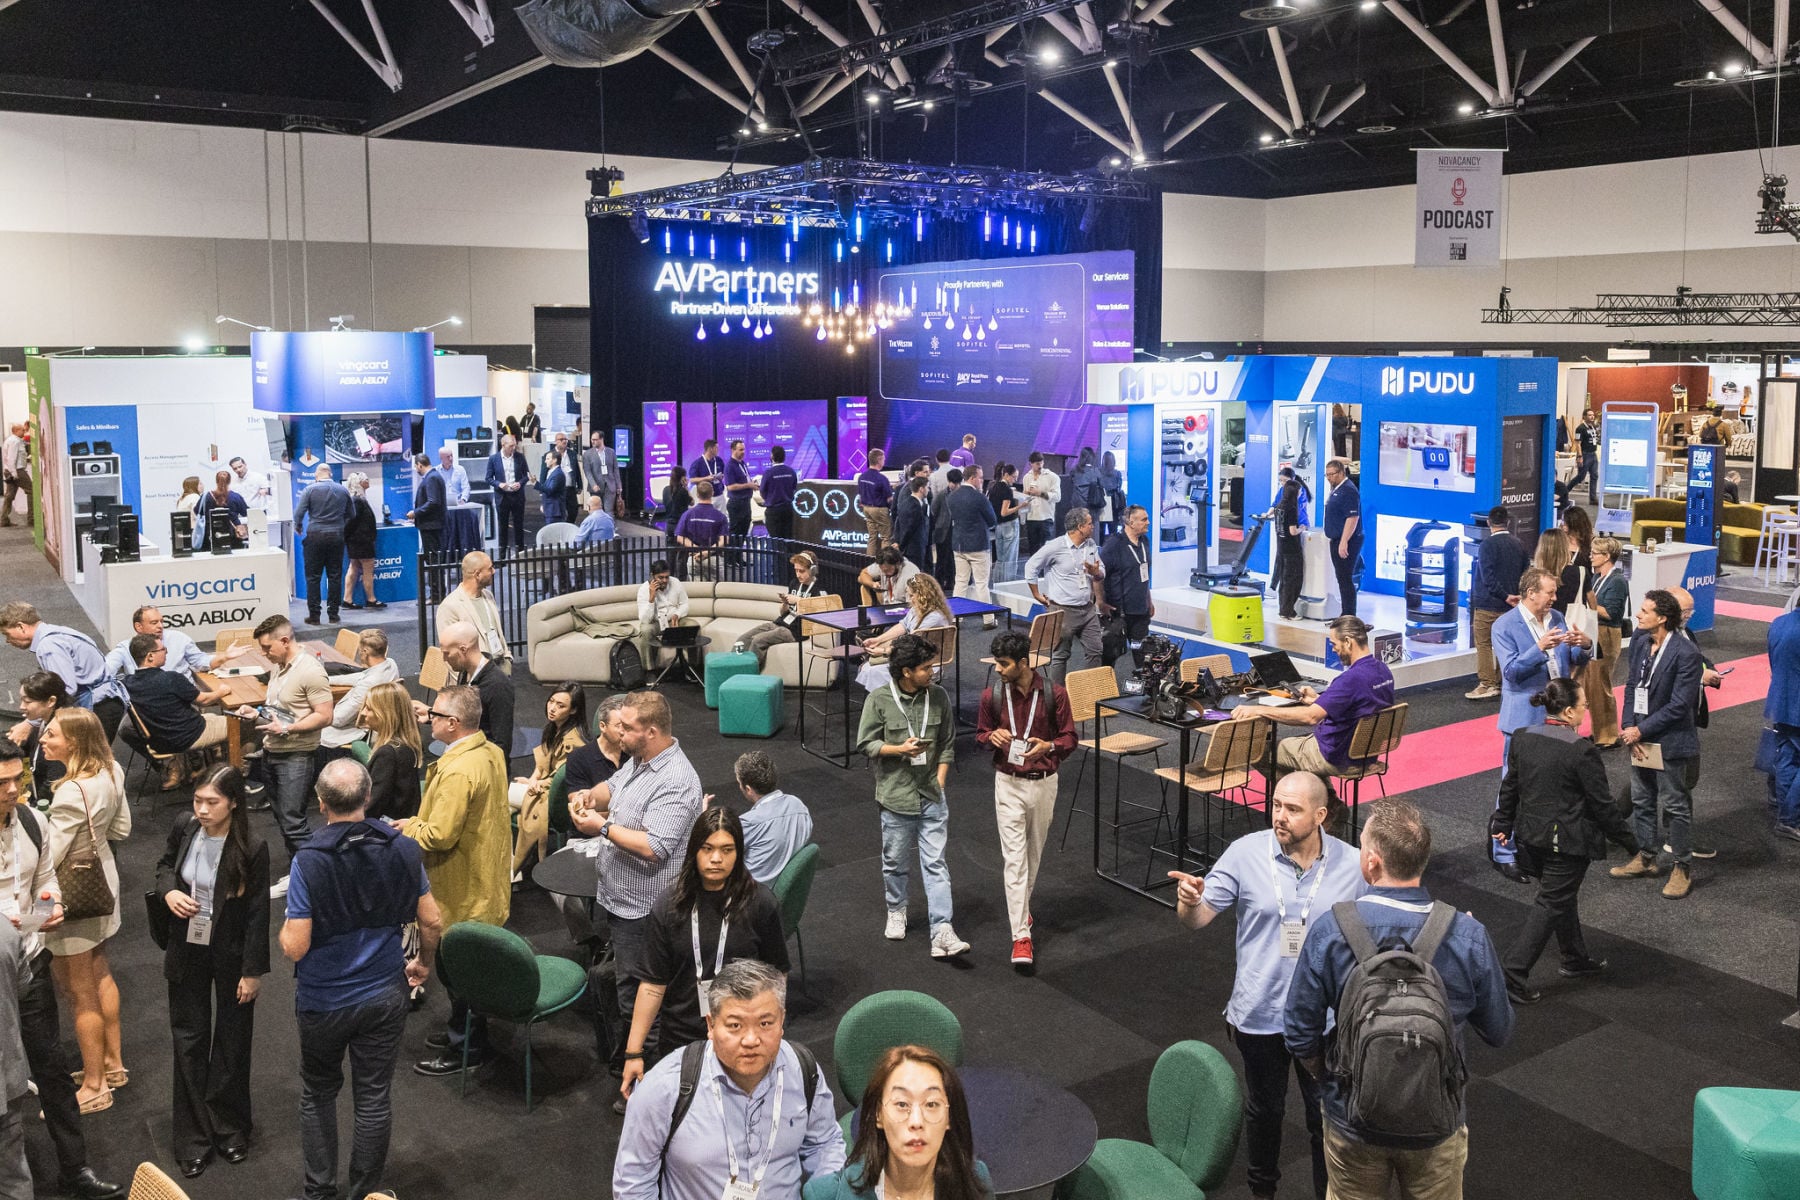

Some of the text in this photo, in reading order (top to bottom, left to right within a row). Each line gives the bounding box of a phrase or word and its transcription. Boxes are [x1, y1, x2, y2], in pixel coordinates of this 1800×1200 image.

[1438, 156, 1480, 166] NOVACANCY
[1423, 210, 1493, 228] PODCAST
[654, 262, 819, 294] AVPartners
[1093, 272, 1129, 282] Our Services
[964, 280, 990, 290] Partnering
[992, 280, 1004, 288] with
[671, 301, 746, 316] Partner-Driven
[339, 360, 389, 372] vingcard
[362, 375, 389, 385] ABLOY
[1151, 370, 1218, 397] PUDU
[1408, 371, 1475, 395] PUDU
[1501, 493, 1534, 505] PUDU CC1
[821, 529, 870, 541] AVPartne
[379, 570, 402, 581] ABLOY
[1695, 574, 1716, 588] PUDU
[145, 573, 256, 600] vingcard
[162, 606, 256, 630] SSA ABLOY
